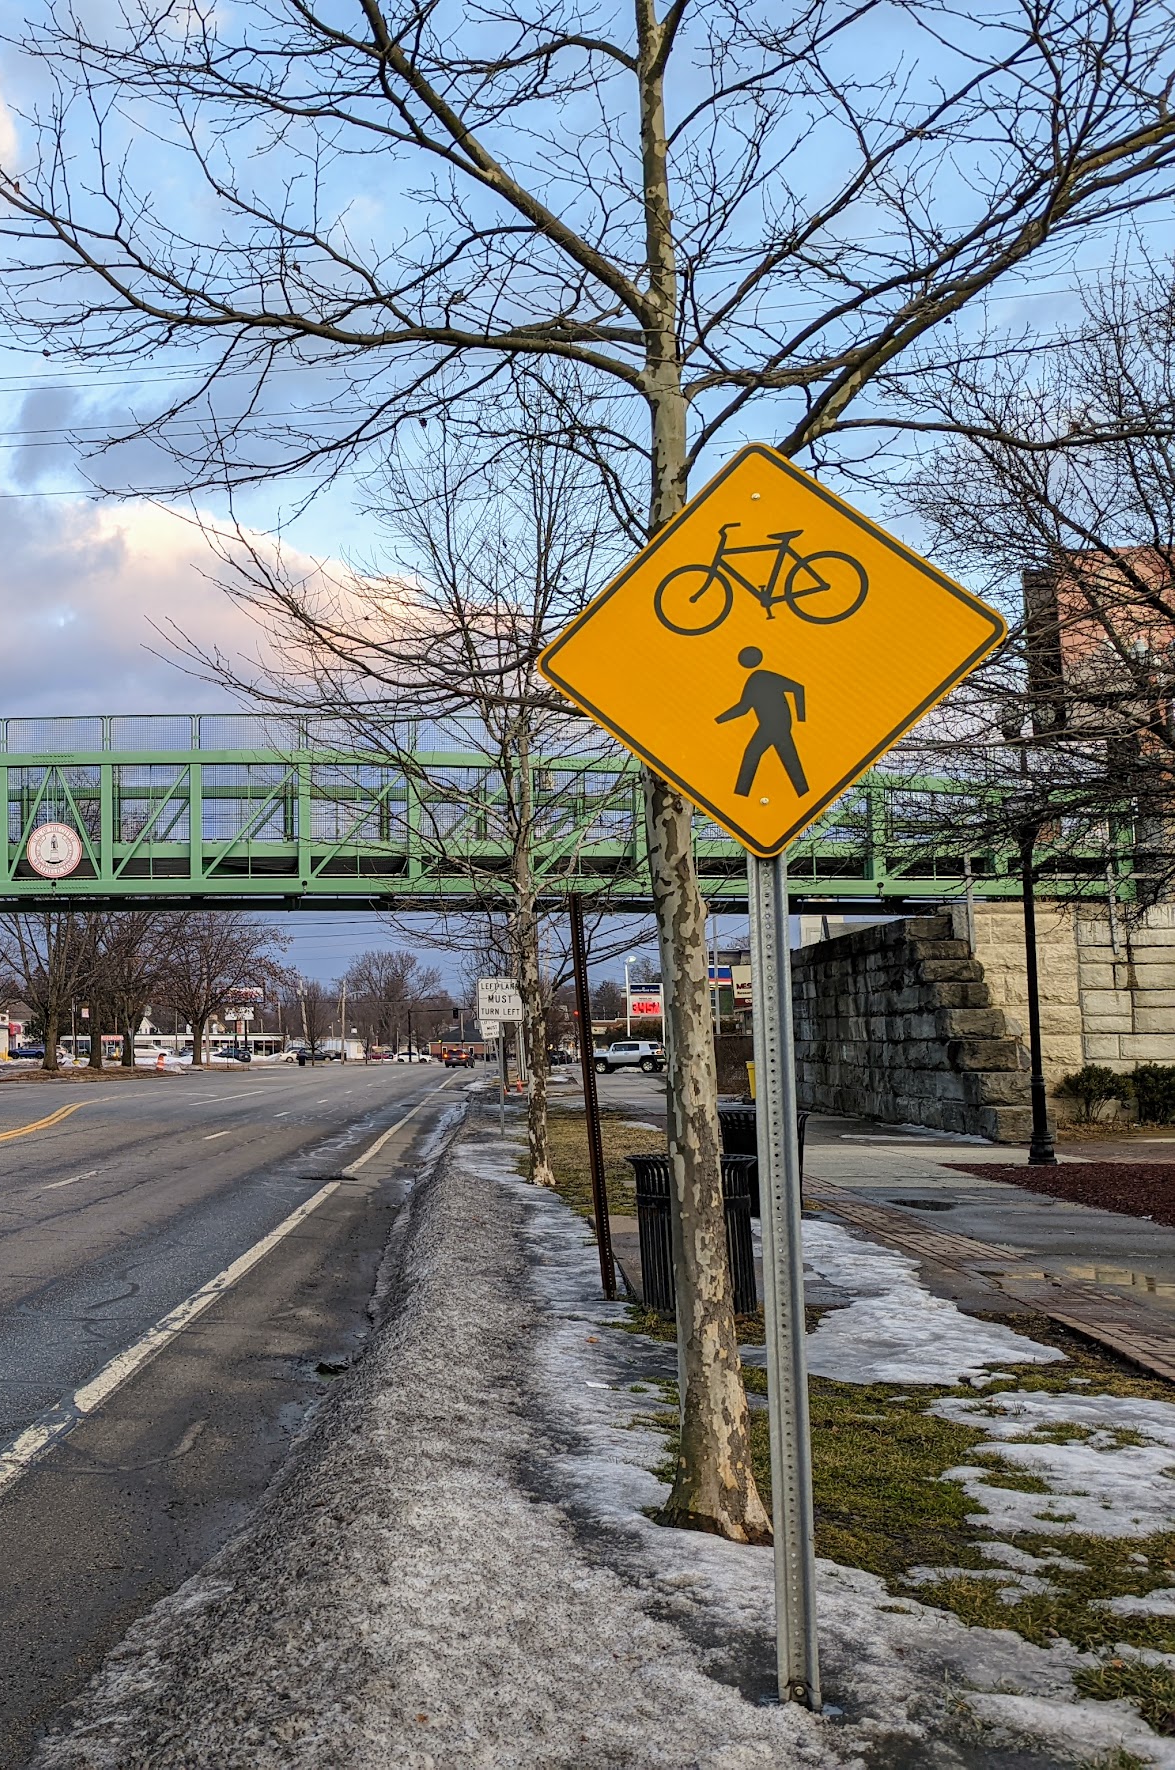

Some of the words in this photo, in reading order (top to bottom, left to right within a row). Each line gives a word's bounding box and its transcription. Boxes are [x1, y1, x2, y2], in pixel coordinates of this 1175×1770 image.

[480, 982, 499, 990] LEFT
[487, 994, 512, 1004] MUST
[480, 1007, 500, 1016] TURN
[502, 1008, 521, 1016] LEFT
